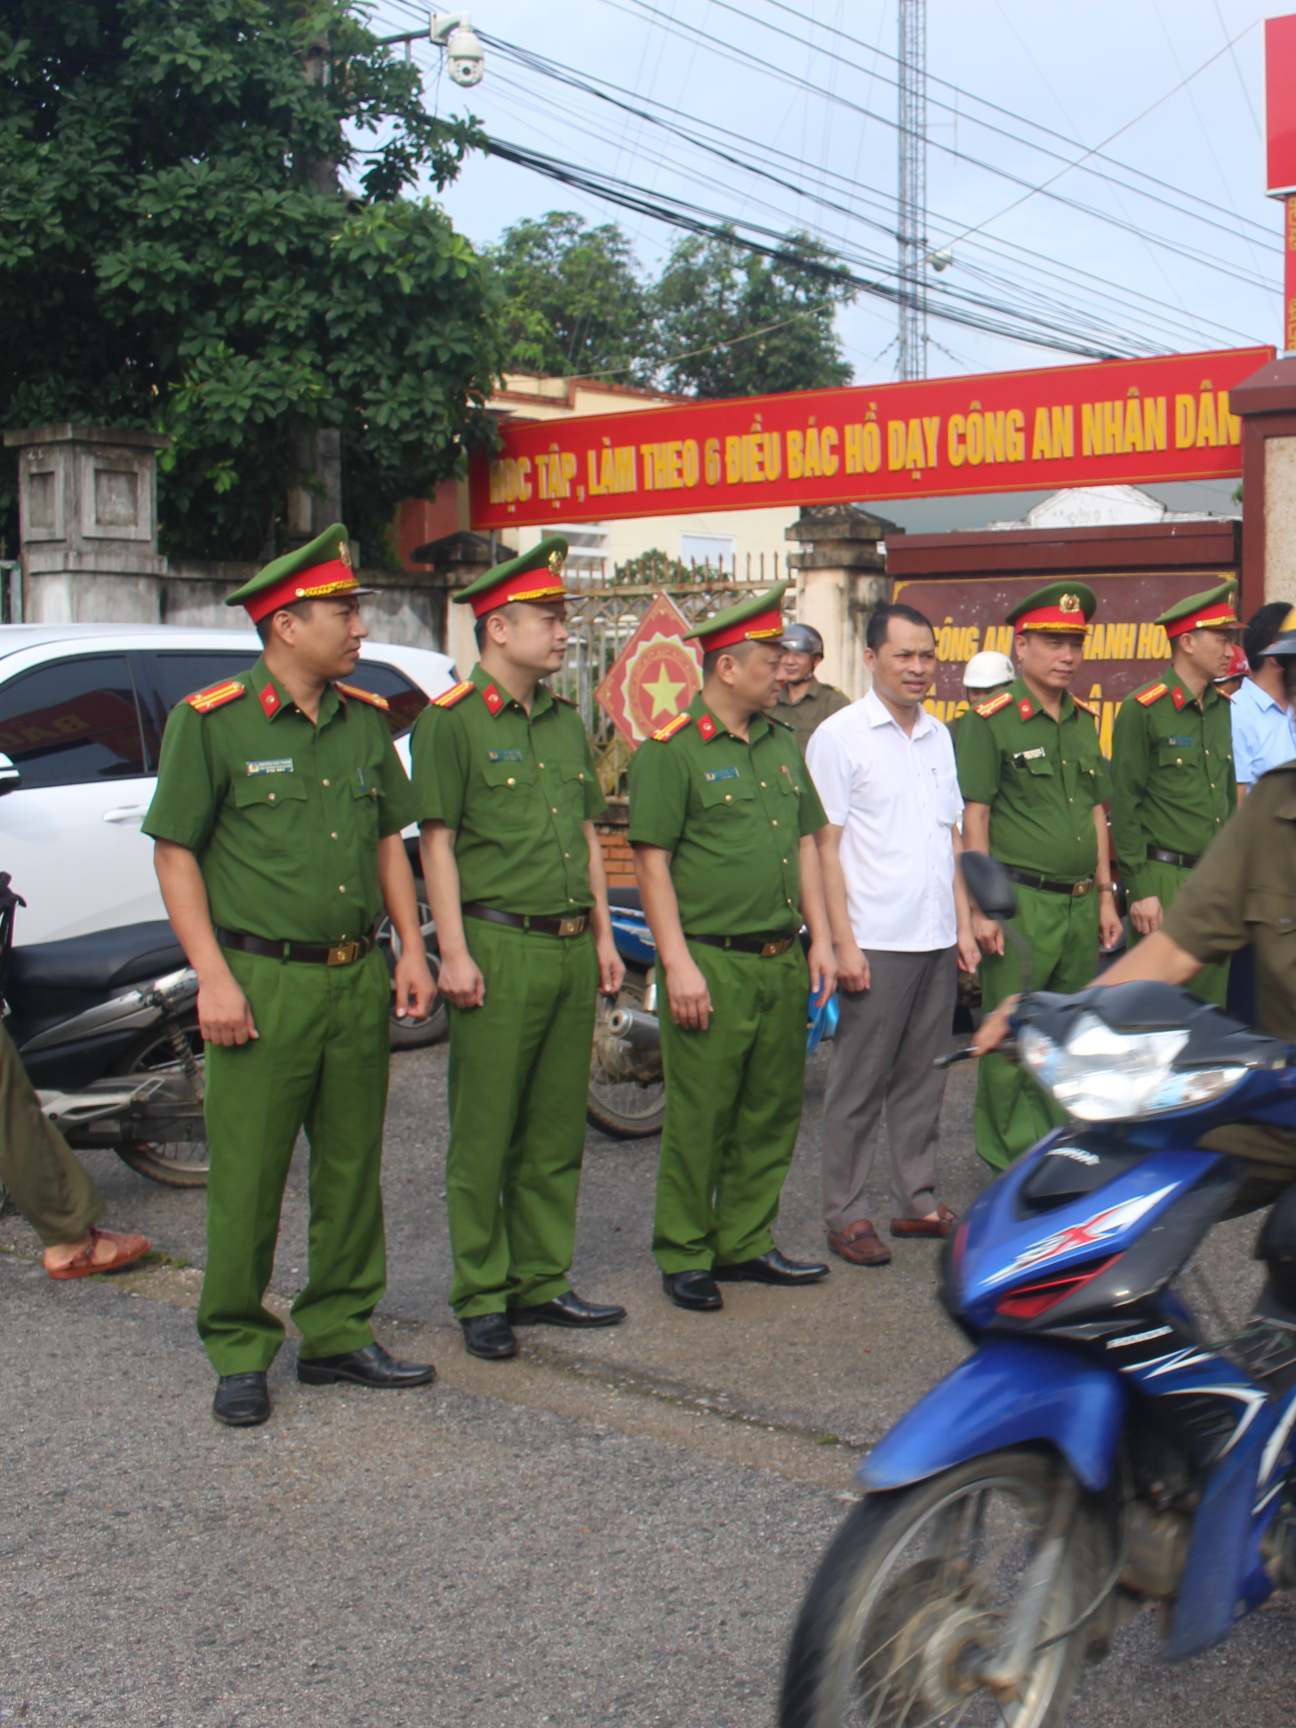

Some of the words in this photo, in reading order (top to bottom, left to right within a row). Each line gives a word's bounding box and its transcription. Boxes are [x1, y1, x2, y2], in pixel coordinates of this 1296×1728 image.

[489, 455, 532, 513] HỌC
[587, 436, 637, 496] LÀM
[640, 438, 699, 491] THEO
[704, 437, 720, 486] 6
[725, 413, 781, 485] ĐIỀU
[786, 415, 839, 480] BÁC
[844, 401, 881, 474] HỒ
[887, 416, 940, 481] DẠY
[947, 400, 1025, 467] CÔNG
[1031, 405, 1074, 460] AN
[1082, 386, 1166, 457] NHÂN
[1174, 379, 1242, 450] DÂN
[983, 625, 1015, 658] AN
